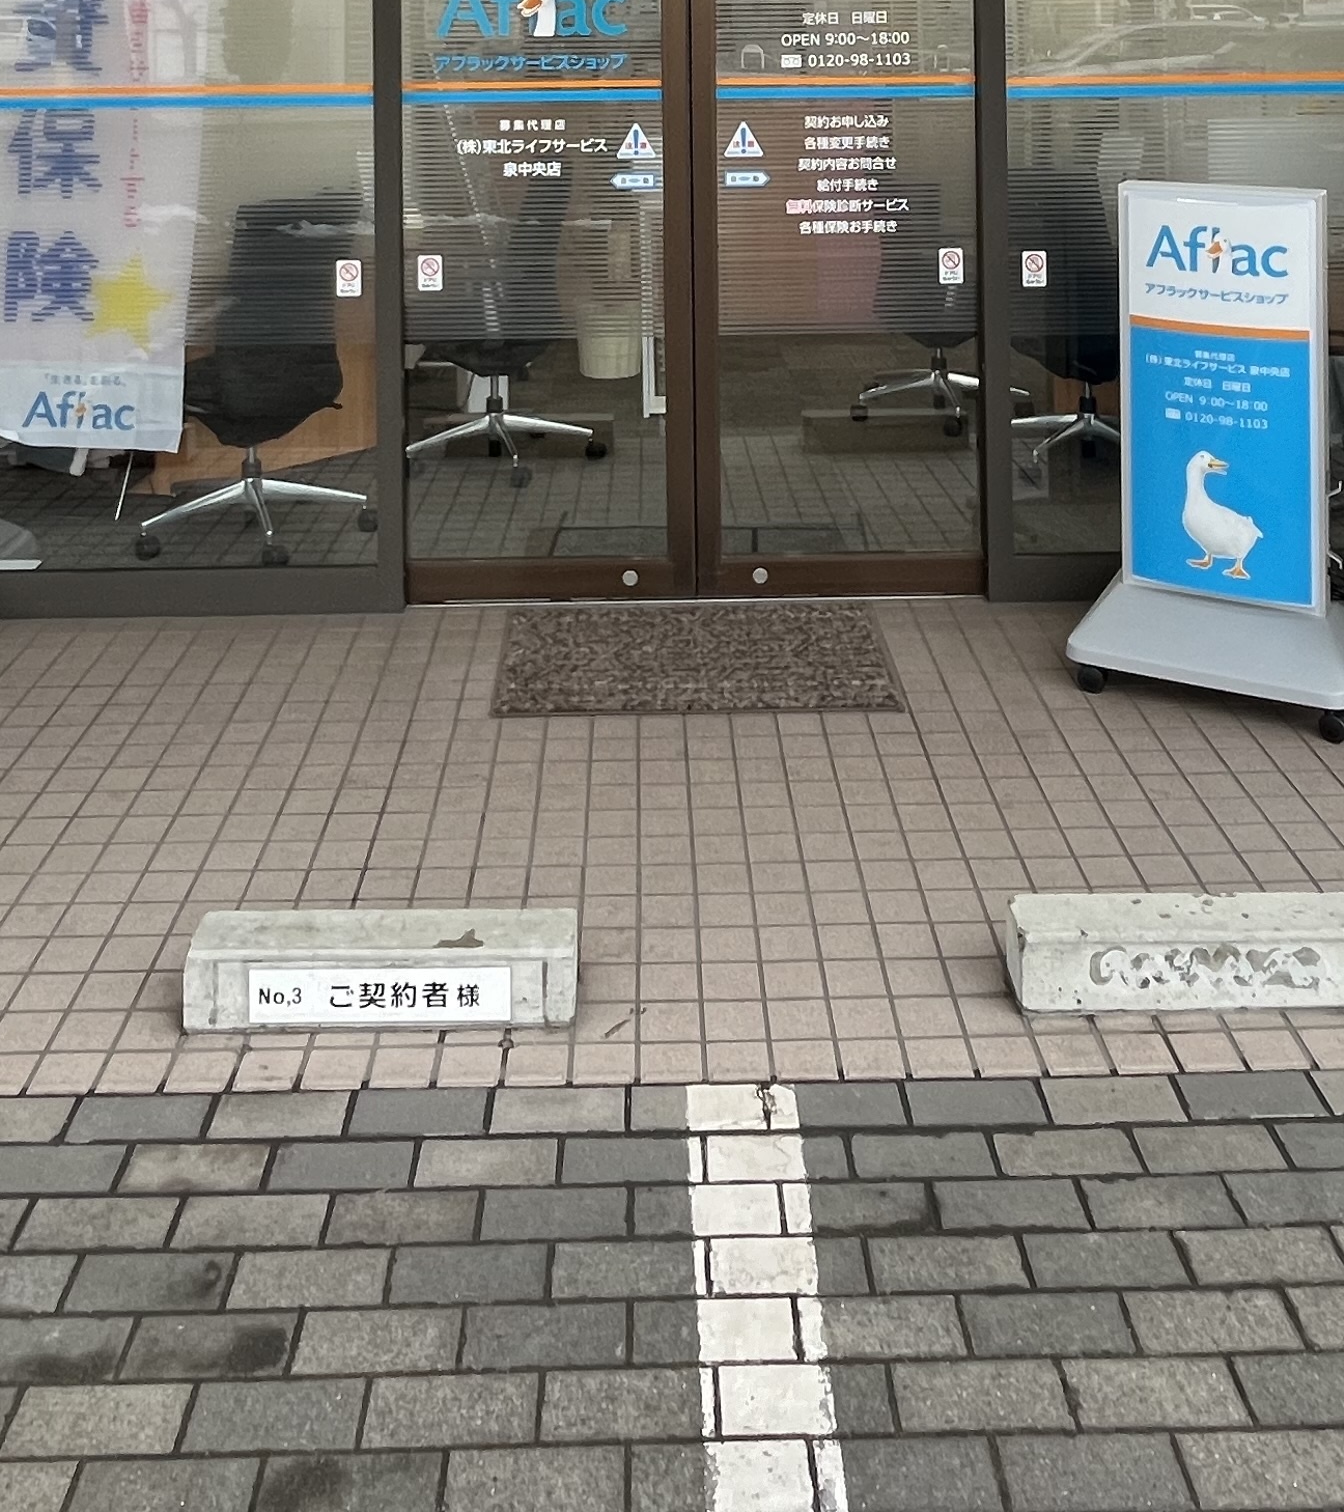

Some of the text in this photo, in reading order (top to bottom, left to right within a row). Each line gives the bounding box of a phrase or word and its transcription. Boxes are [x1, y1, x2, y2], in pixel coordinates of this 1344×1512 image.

[802, 10, 888, 25] 定休日 日曜日
[781, 33, 821, 46] OPEN
[435, 53, 628, 73] アフラックサービスショップ
[808, 53, 911, 68] 0120-98-1103
[804, 114, 890, 129] 契約お申し込み
[804, 135, 891, 151] 各種変更手続き
[503, 161, 562, 178] 泉中央店
[798, 156, 897, 172] 契約内容お問合せ
[1144, 282, 1290, 306] アフラックサービスショップ
[1165, 391, 1193, 403] OPEN
[329, 981, 481, 1009] ご契約者様
